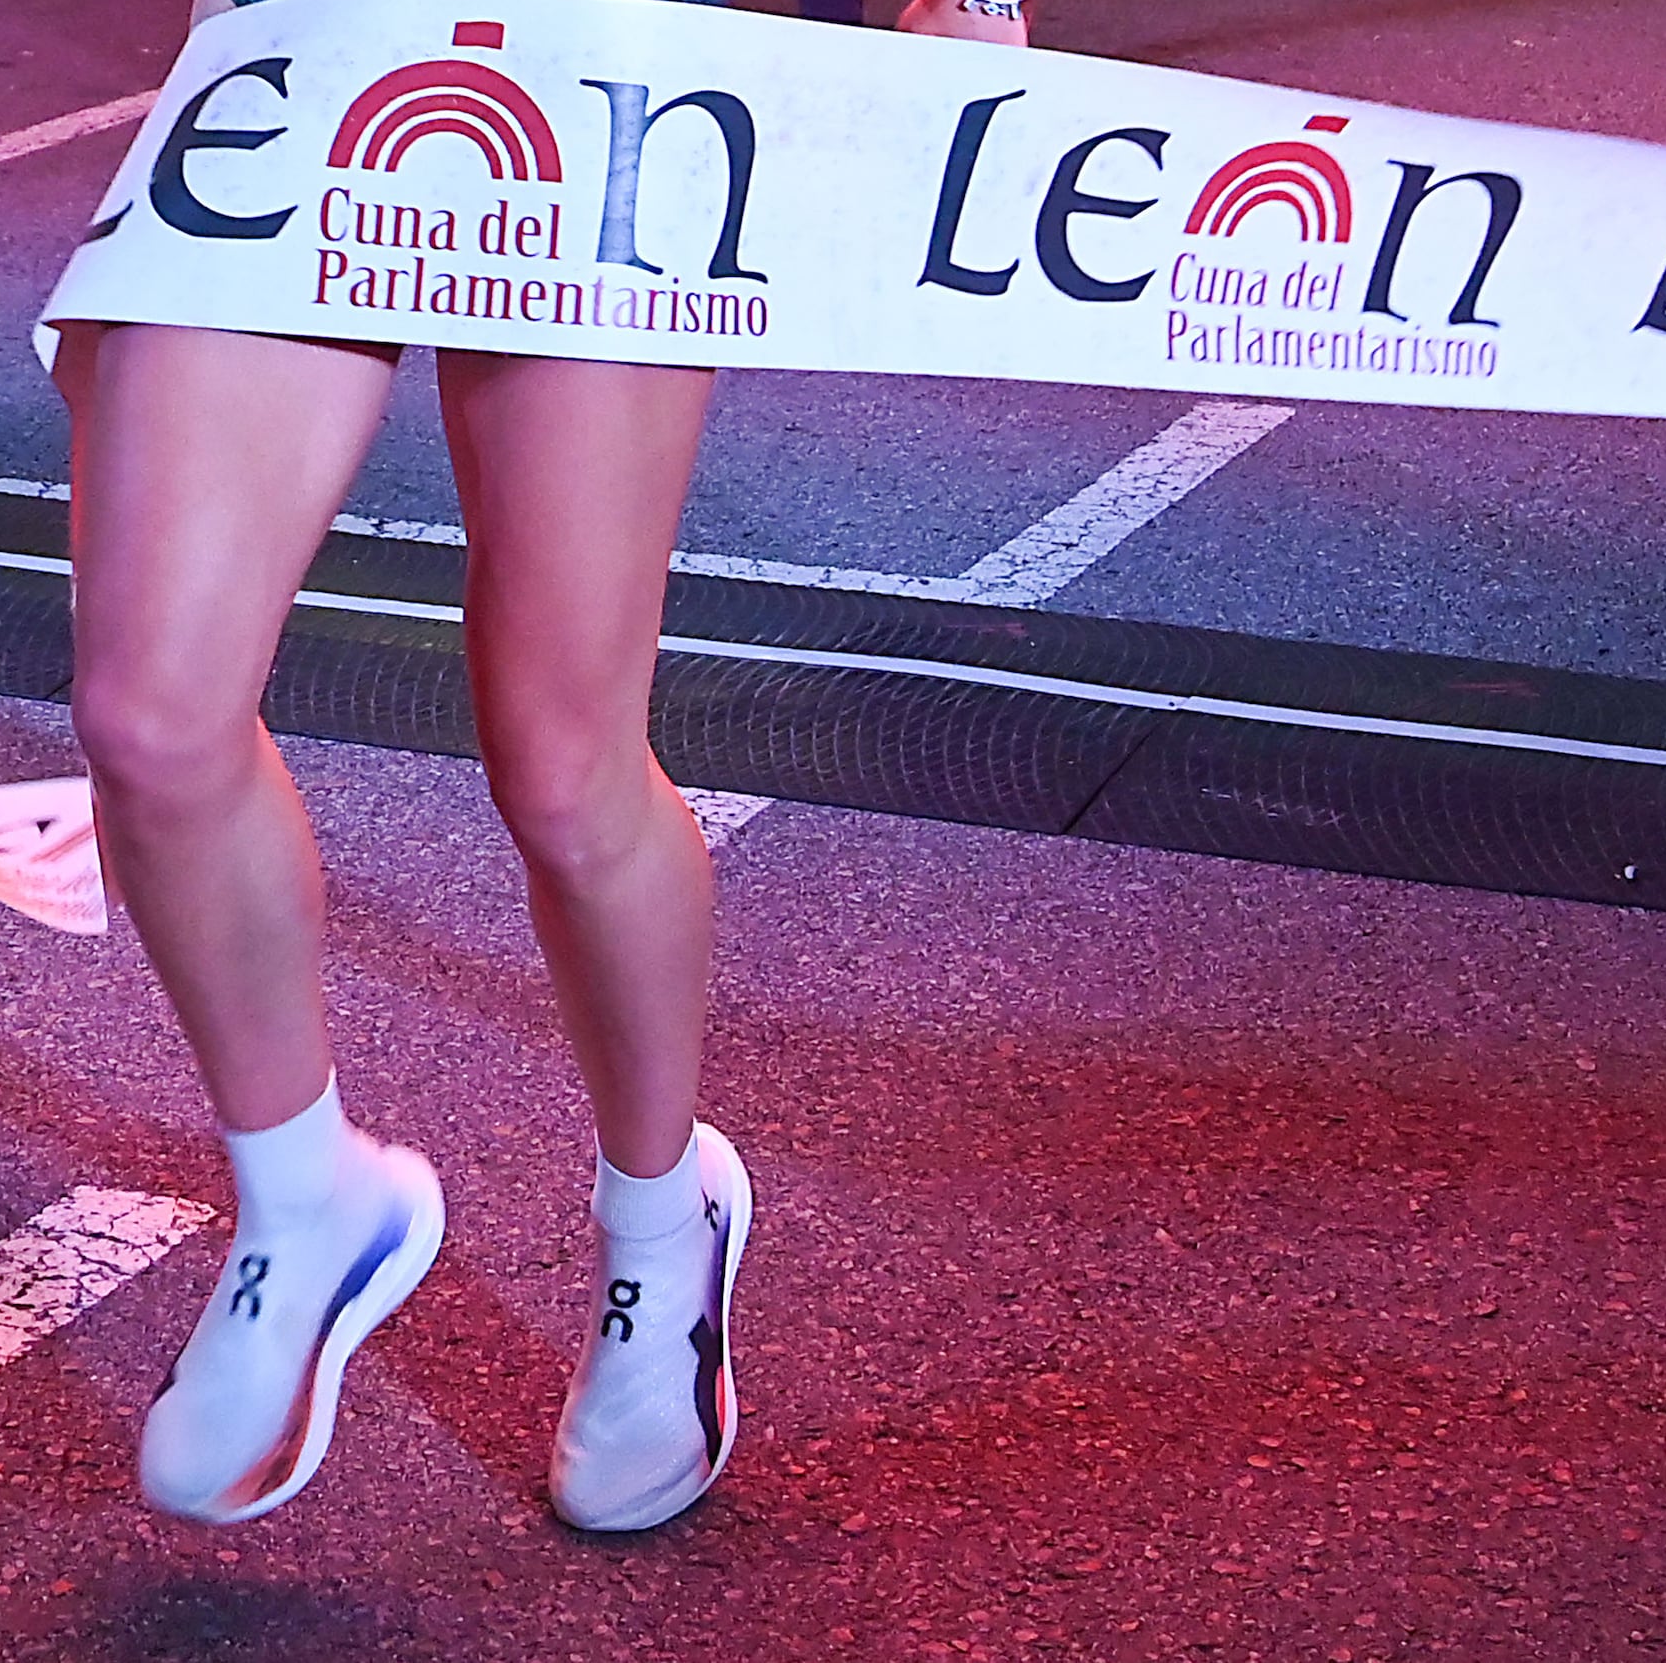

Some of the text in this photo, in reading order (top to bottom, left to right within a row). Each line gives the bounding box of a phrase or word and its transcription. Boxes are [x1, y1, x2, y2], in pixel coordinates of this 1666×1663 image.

[319, 187, 563, 261] Cuna del
[312, 248, 769, 338] Parlamentarismo
[1170, 252, 1344, 314] Cuna del
[1165, 308, 1498, 379] Parlamentarismo
